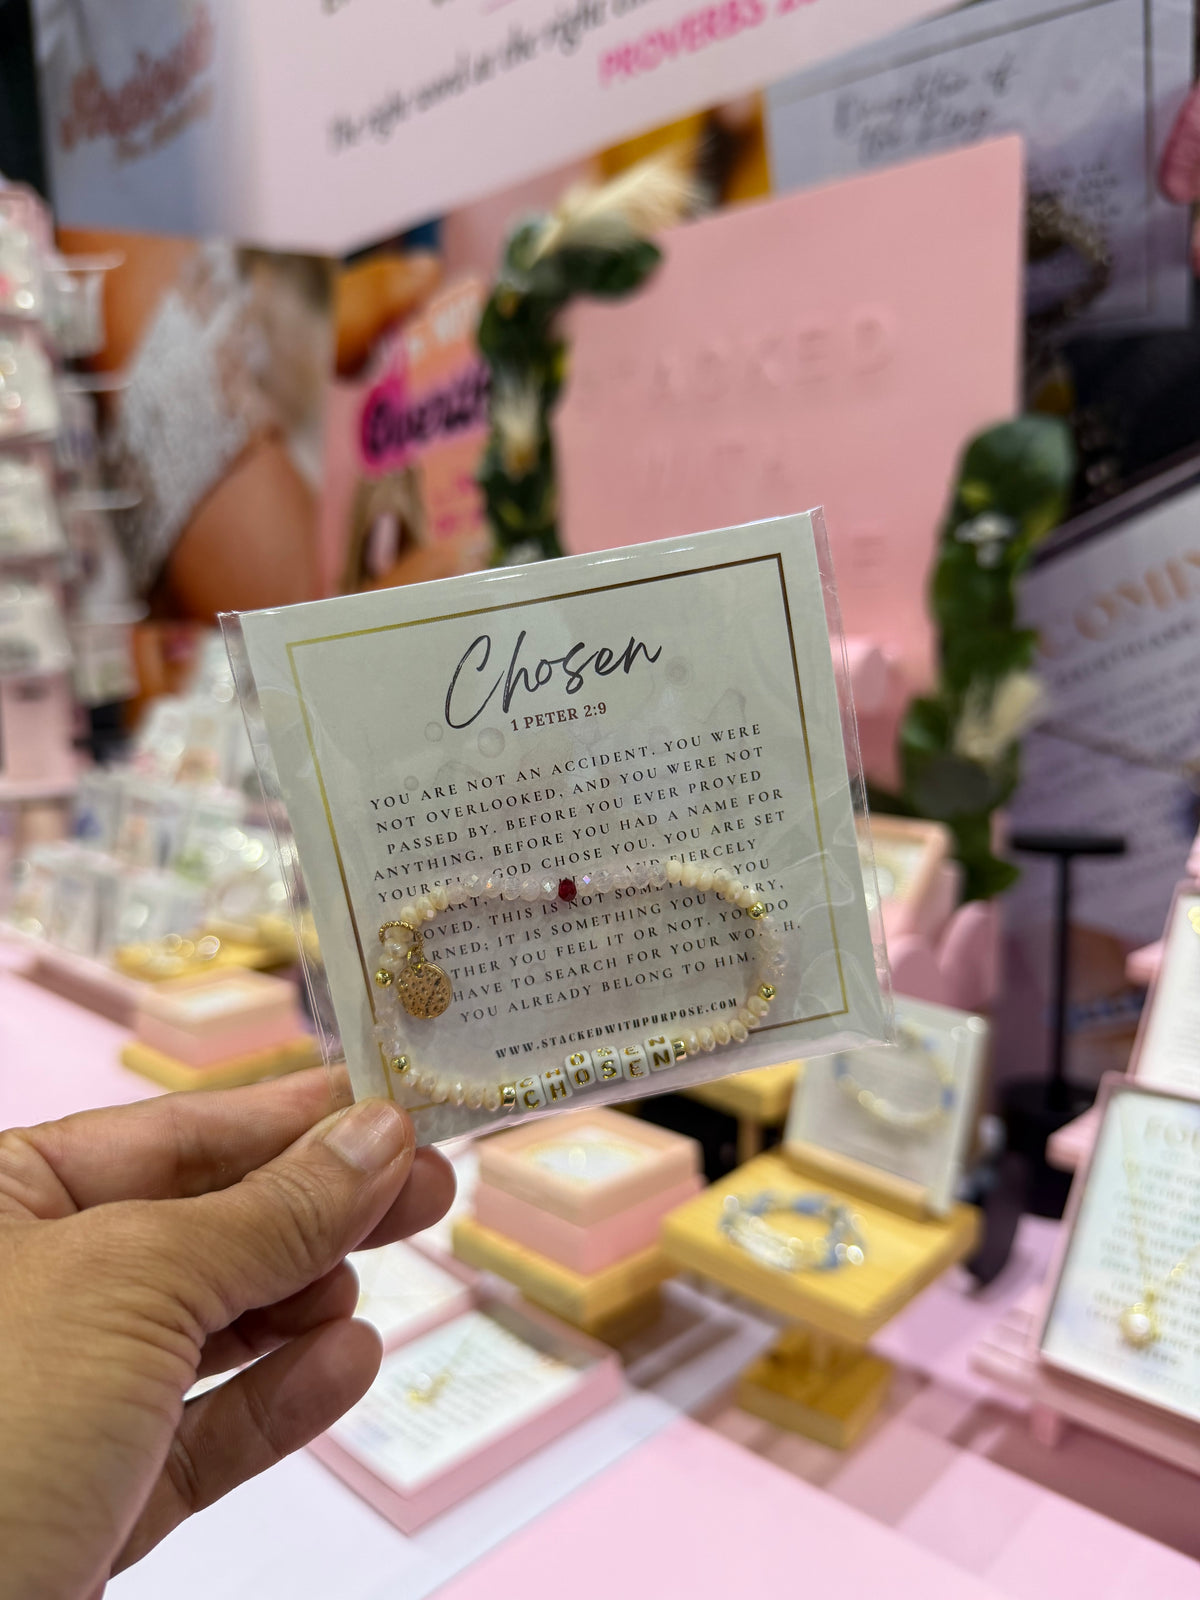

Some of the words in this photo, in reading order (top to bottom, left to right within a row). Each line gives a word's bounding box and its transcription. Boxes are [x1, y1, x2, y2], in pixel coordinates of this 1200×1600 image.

[445, 630, 662, 729] Chosen
[511, 718, 518, 731] 1
[523, 708, 578, 729] PETER
[584, 702, 606, 718] 2:9
[370, 793, 409, 810] YOU
[421, 784, 457, 800] ARE
[467, 774, 505, 791] NOT
[516, 768, 540, 782] AN
[551, 746, 655, 775] ACCIDENT.
[664, 736, 700, 752] YOU
[711, 724, 760, 742] WERE
[376, 816, 415, 833] NOT
[427, 788, 563, 822] OVERLOOKED,
[573, 778, 610, 795] AND
[620, 768, 656, 784] YOU
[667, 756, 716, 774] WERE
[725, 746, 762, 763] NOT
[387, 832, 457, 854] PASSED
[468, 824, 496, 838] BY.
[506, 807, 577, 830] BEFORE
[586, 798, 623, 814] YOU
[634, 787, 678, 805] EVER
[689, 770, 760, 793] PROVED
[493, 833, 563, 857] BEFORE
[572, 823, 609, 839] YOU
[620, 814, 657, 831] HAD
[668, 811, 678, 821] A
[688, 798, 738, 816] NAME
[748, 789, 782, 804] FOR
[541, 848, 602, 869] CHOSE
[611, 838, 655, 854] YOU.
[664, 828, 699, 844] YOU
[711, 819, 744, 835] ARE
[755, 811, 784, 826] SET
[489, 908, 532, 925] THIS
[543, 902, 558, 914] IS
[568, 893, 604, 909] NOT
[733, 859, 768, 874] YOU
[498, 934, 515, 947] IT
[526, 929, 541, 942] IS
[551, 903, 660, 935] SOMETHING
[670, 893, 706, 910] YOU
[453, 983, 502, 1002] HAVE
[511, 975, 535, 988] TO
[545, 958, 616, 982] SEARCH
[627, 949, 661, 964] FOR
[670, 936, 719, 954] YOUR
[729, 920, 800, 942] WOH.
[510, 950, 545, 967] YOU
[557, 940, 597, 957] FEEL
[607, 933, 623, 946] IT
[634, 926, 658, 940] OR
[667, 917, 710, 934] NOT.
[719, 906, 749, 922] YO
[765, 899, 788, 913] DO
[461, 1006, 497, 1023] YOU
[509, 985, 591, 1013] ALREADY
[602, 968, 672, 992] BELONG
[682, 961, 705, 975] TO
[715, 952, 755, 968] HIM.
[496, 998, 737, 1058] WWW.STACKEDWITHPURPOSE.COM
[523, 1050, 671, 1109] CHOSEN
